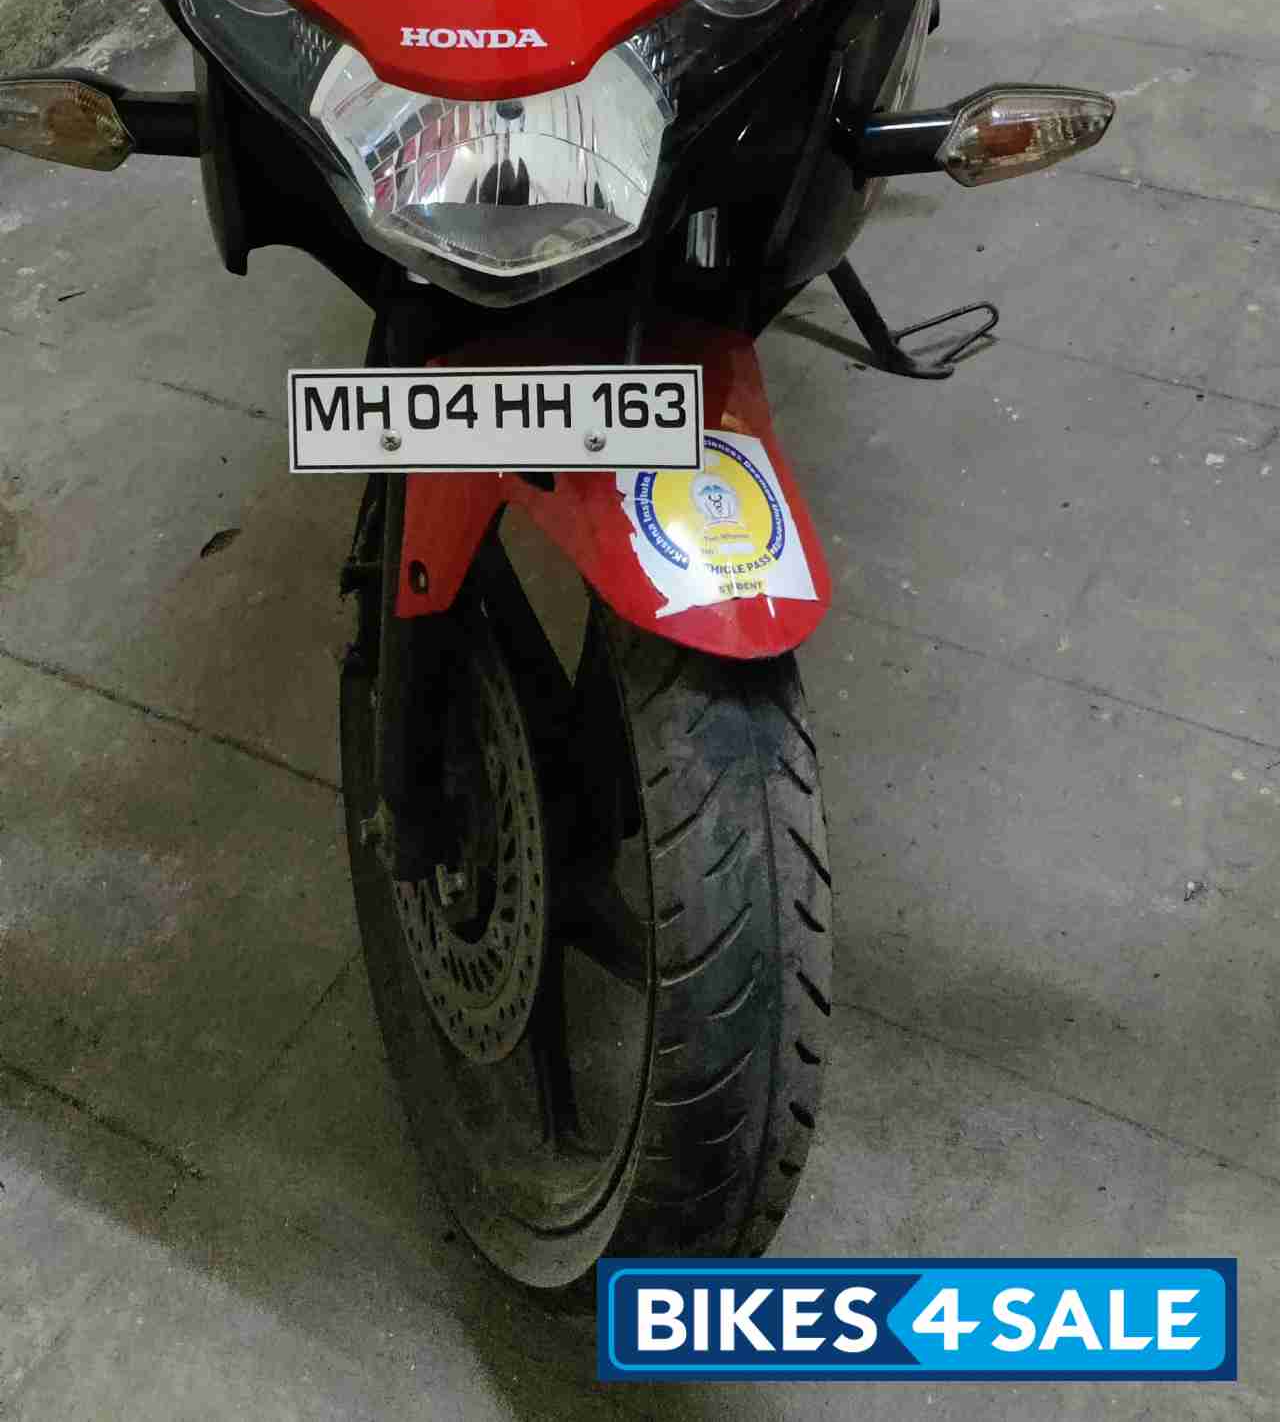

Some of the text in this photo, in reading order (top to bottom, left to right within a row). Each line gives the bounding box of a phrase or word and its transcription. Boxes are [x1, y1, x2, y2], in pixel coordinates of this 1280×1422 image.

[400, 27, 548, 48] HONDA
[303, 382, 687, 432] MH 04 HH 163
